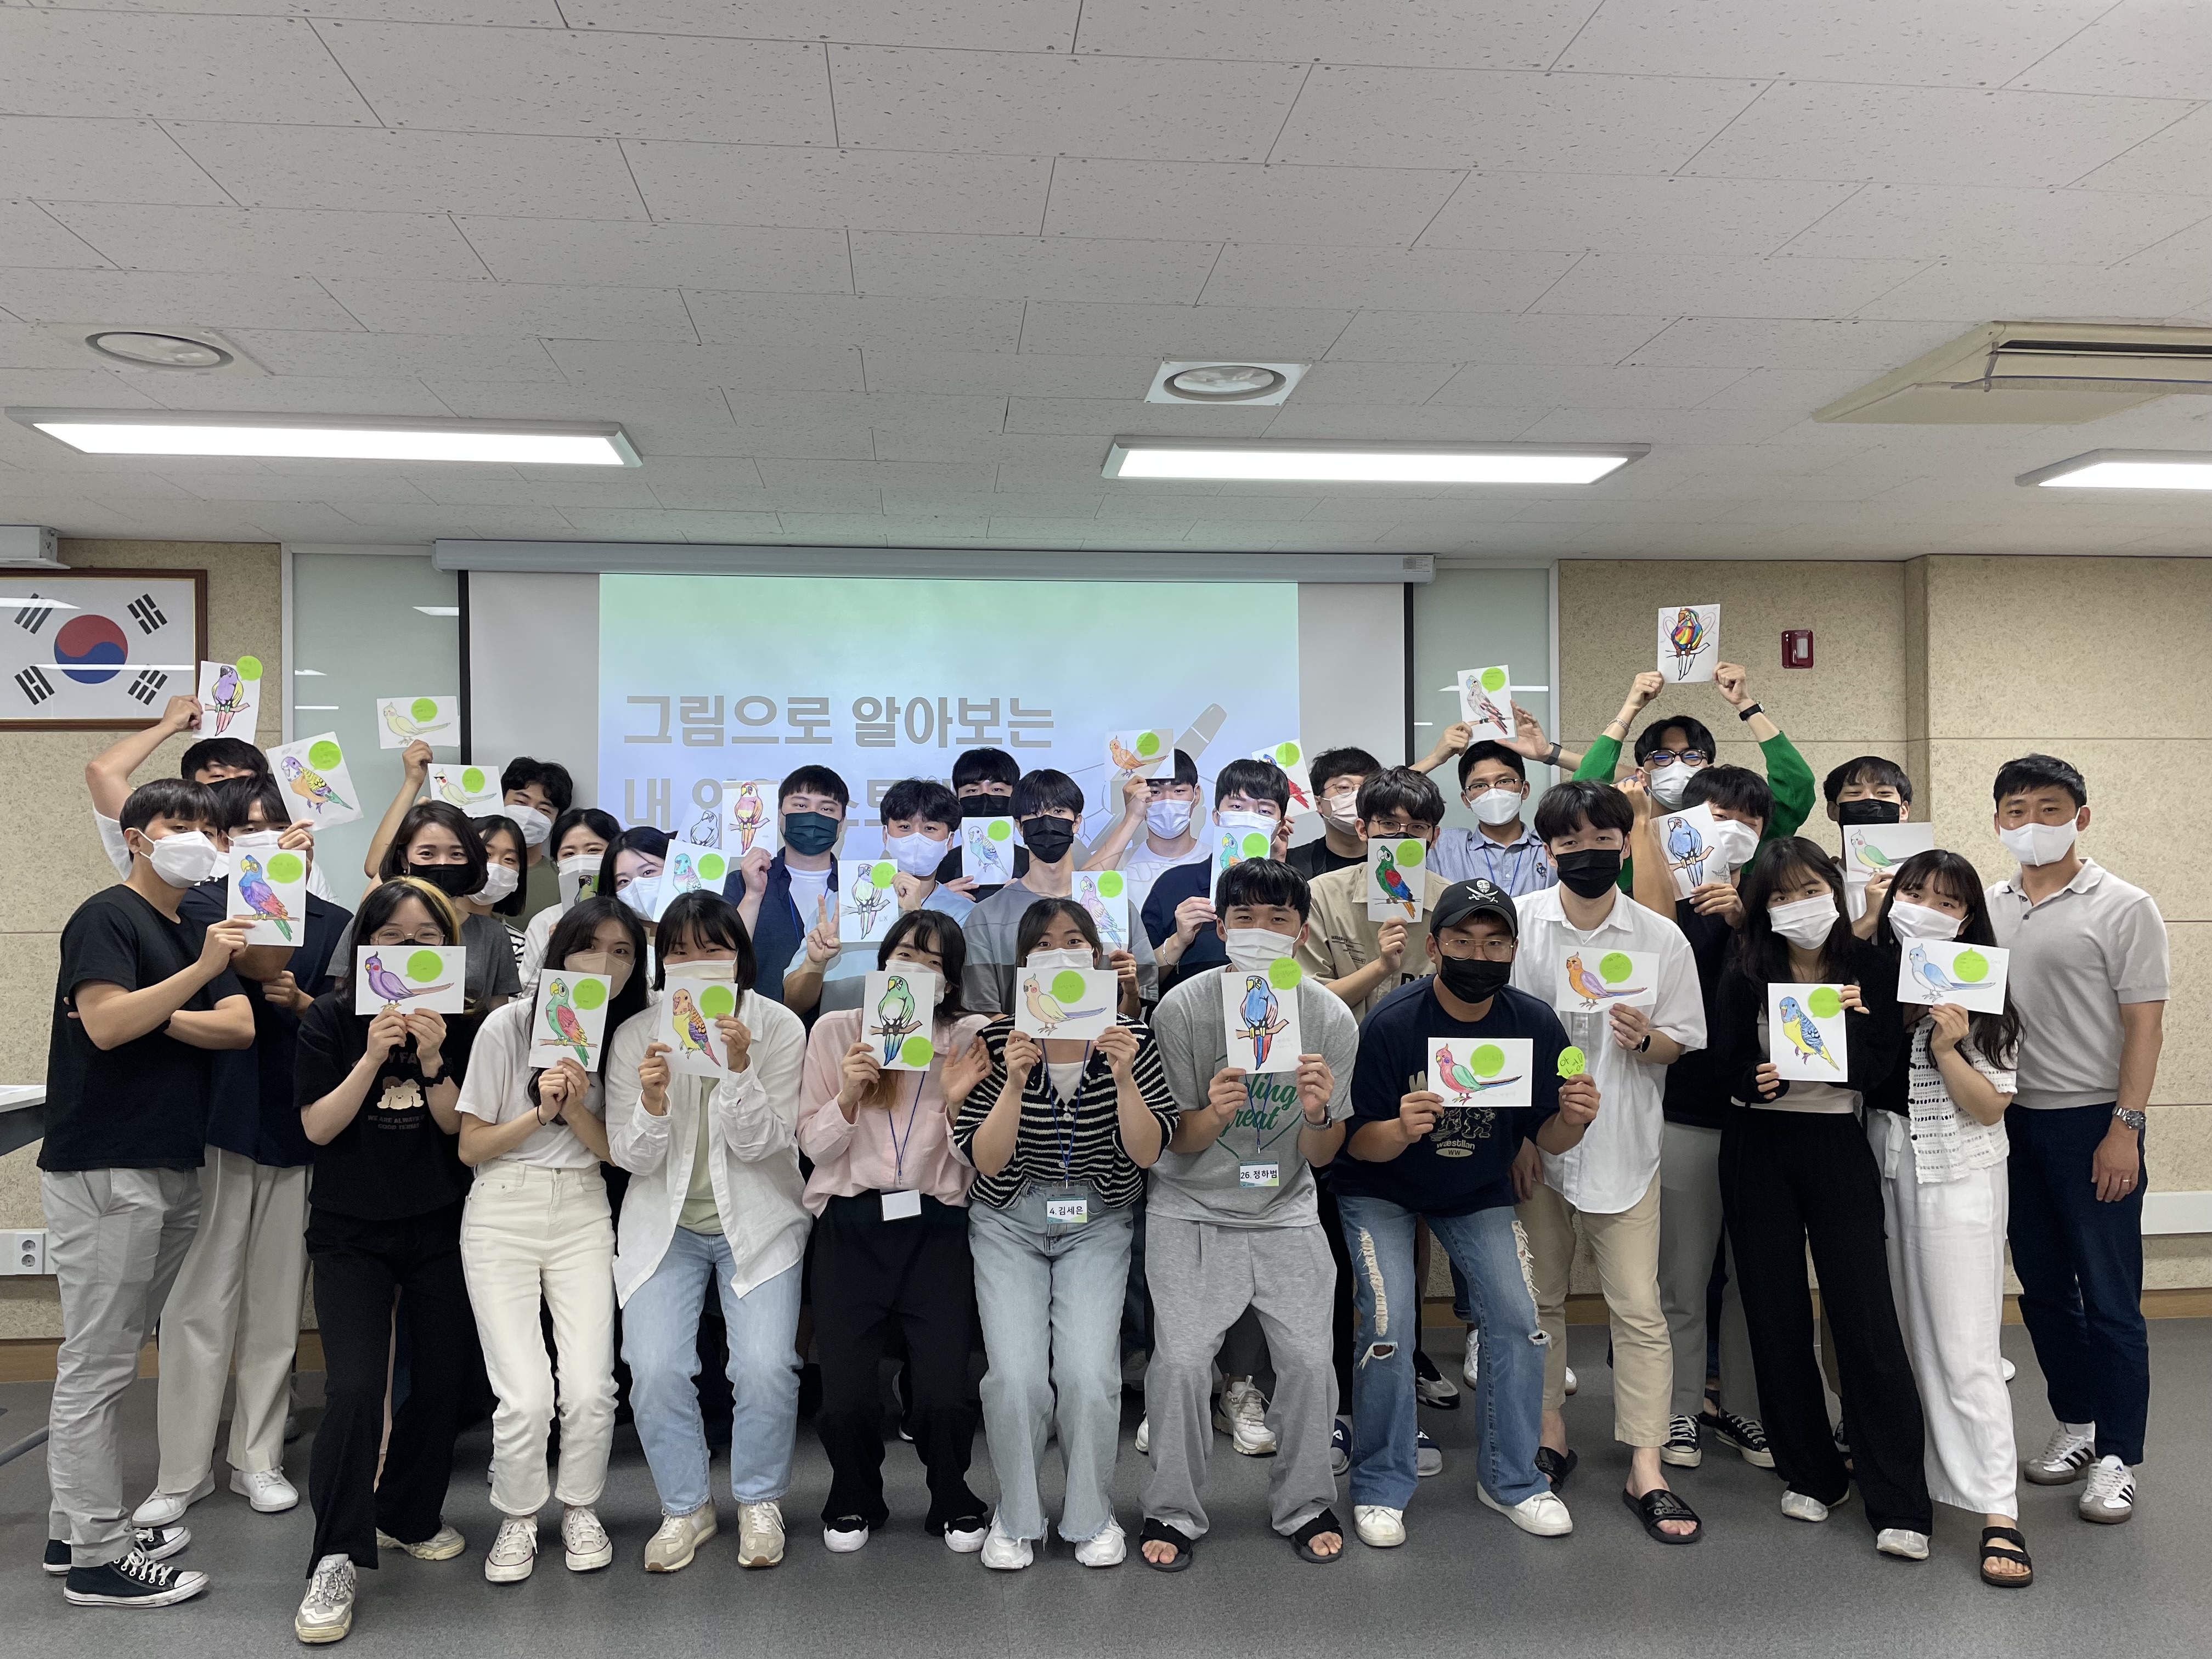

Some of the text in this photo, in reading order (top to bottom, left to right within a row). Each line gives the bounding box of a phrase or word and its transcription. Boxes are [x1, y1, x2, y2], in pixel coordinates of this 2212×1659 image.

[624, 695, 1054, 748] 그림으로 알아보는
[624, 778, 671, 831] 내
[1253, 1170, 1277, 1179] 정하범
[1058, 1206, 1084, 1216] 김세은
